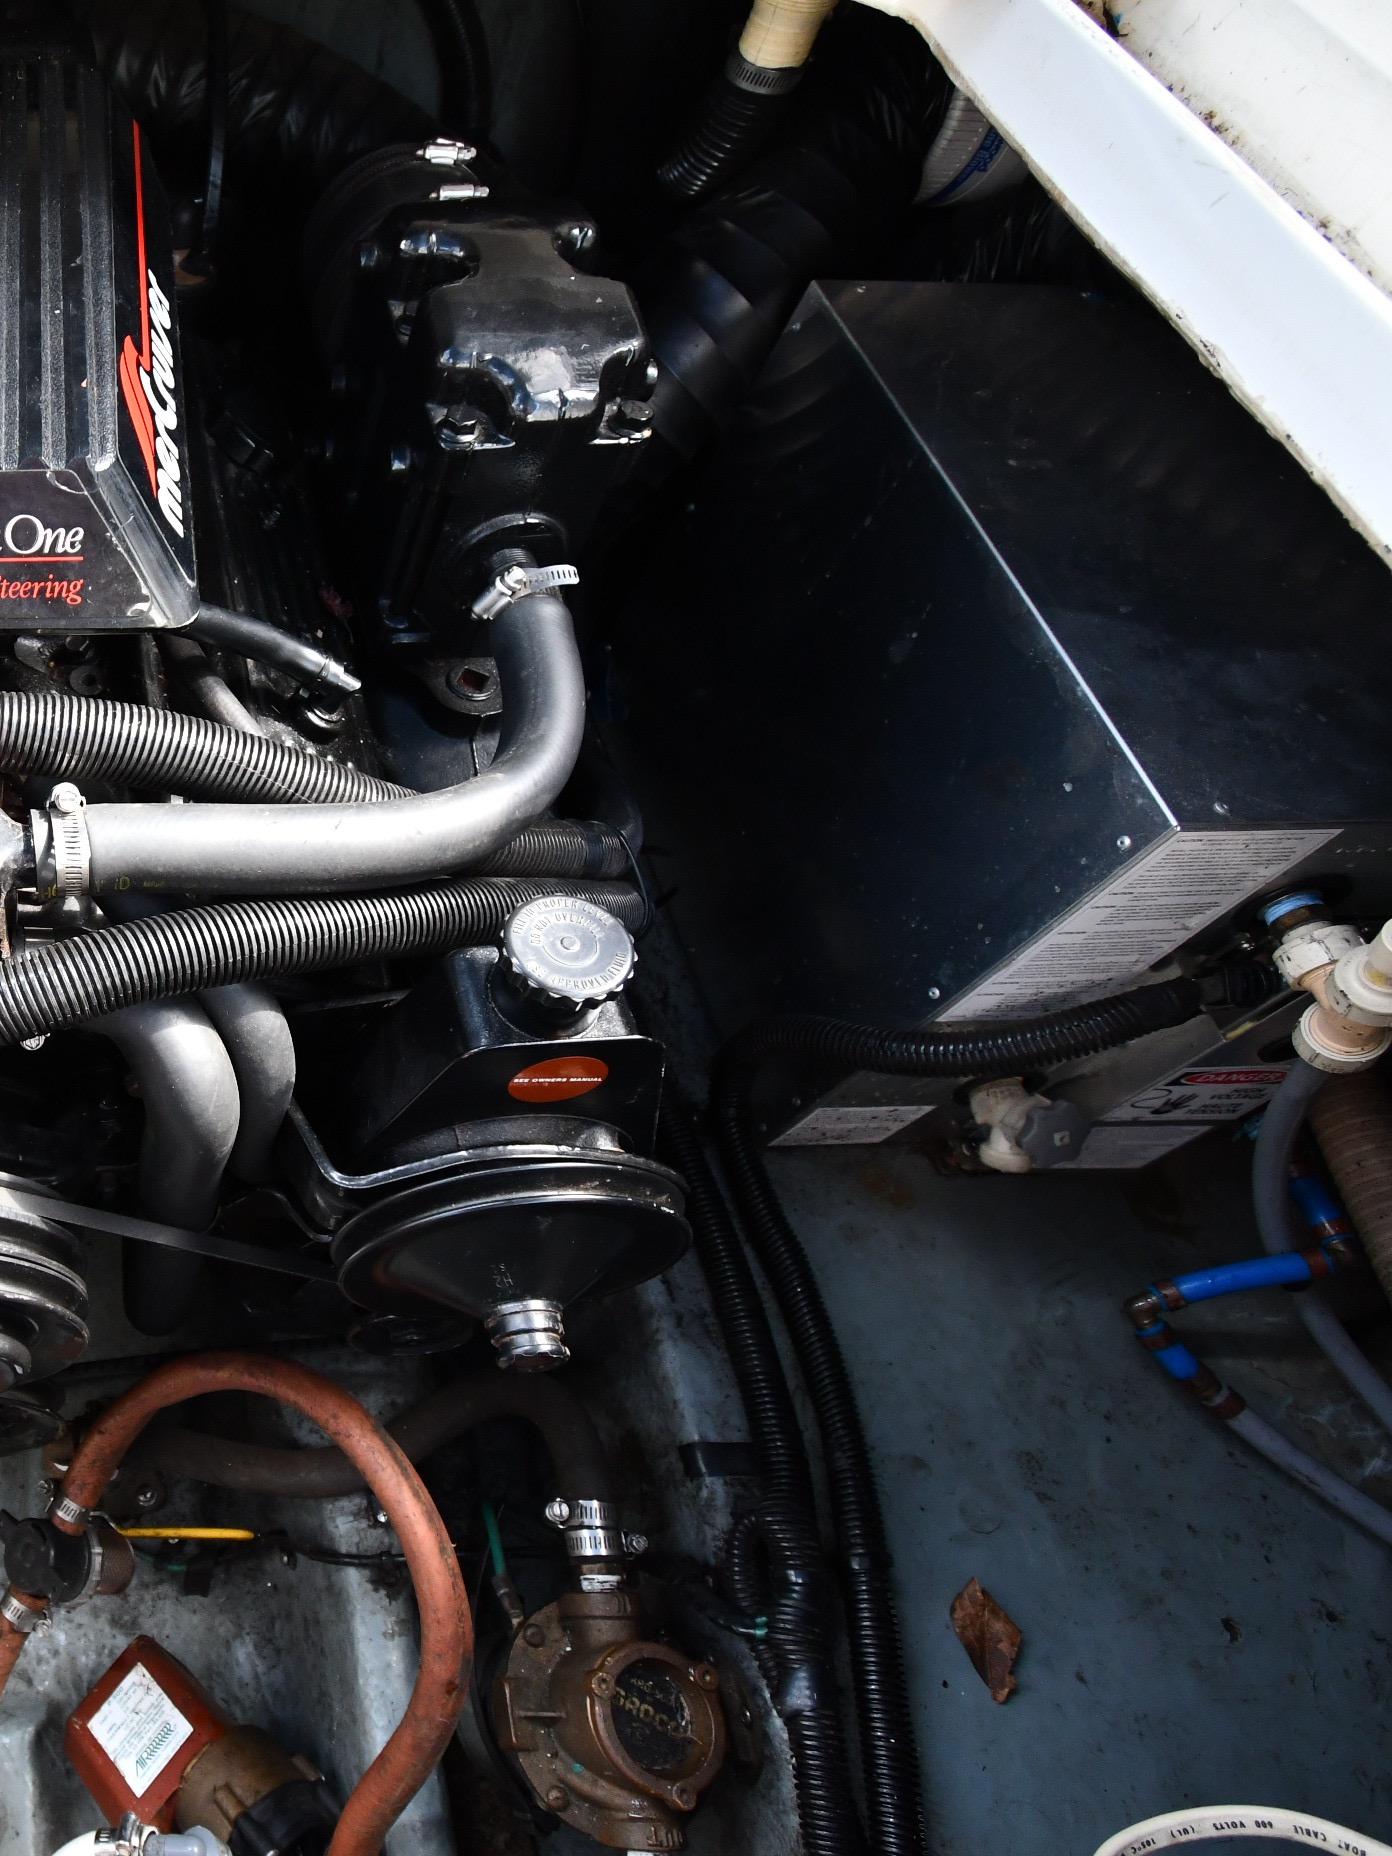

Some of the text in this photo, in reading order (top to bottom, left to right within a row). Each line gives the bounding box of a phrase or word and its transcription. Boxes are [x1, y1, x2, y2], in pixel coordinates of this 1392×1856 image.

[1196, 1073, 1279, 1082] DANGER
[1212, 1820, 1246, 1832] VOLTS
[1254, 1820, 1273, 1830] 600
[1169, 1825, 1196, 1839] (UL)
[1292, 1824, 1327, 1842] CABLE
